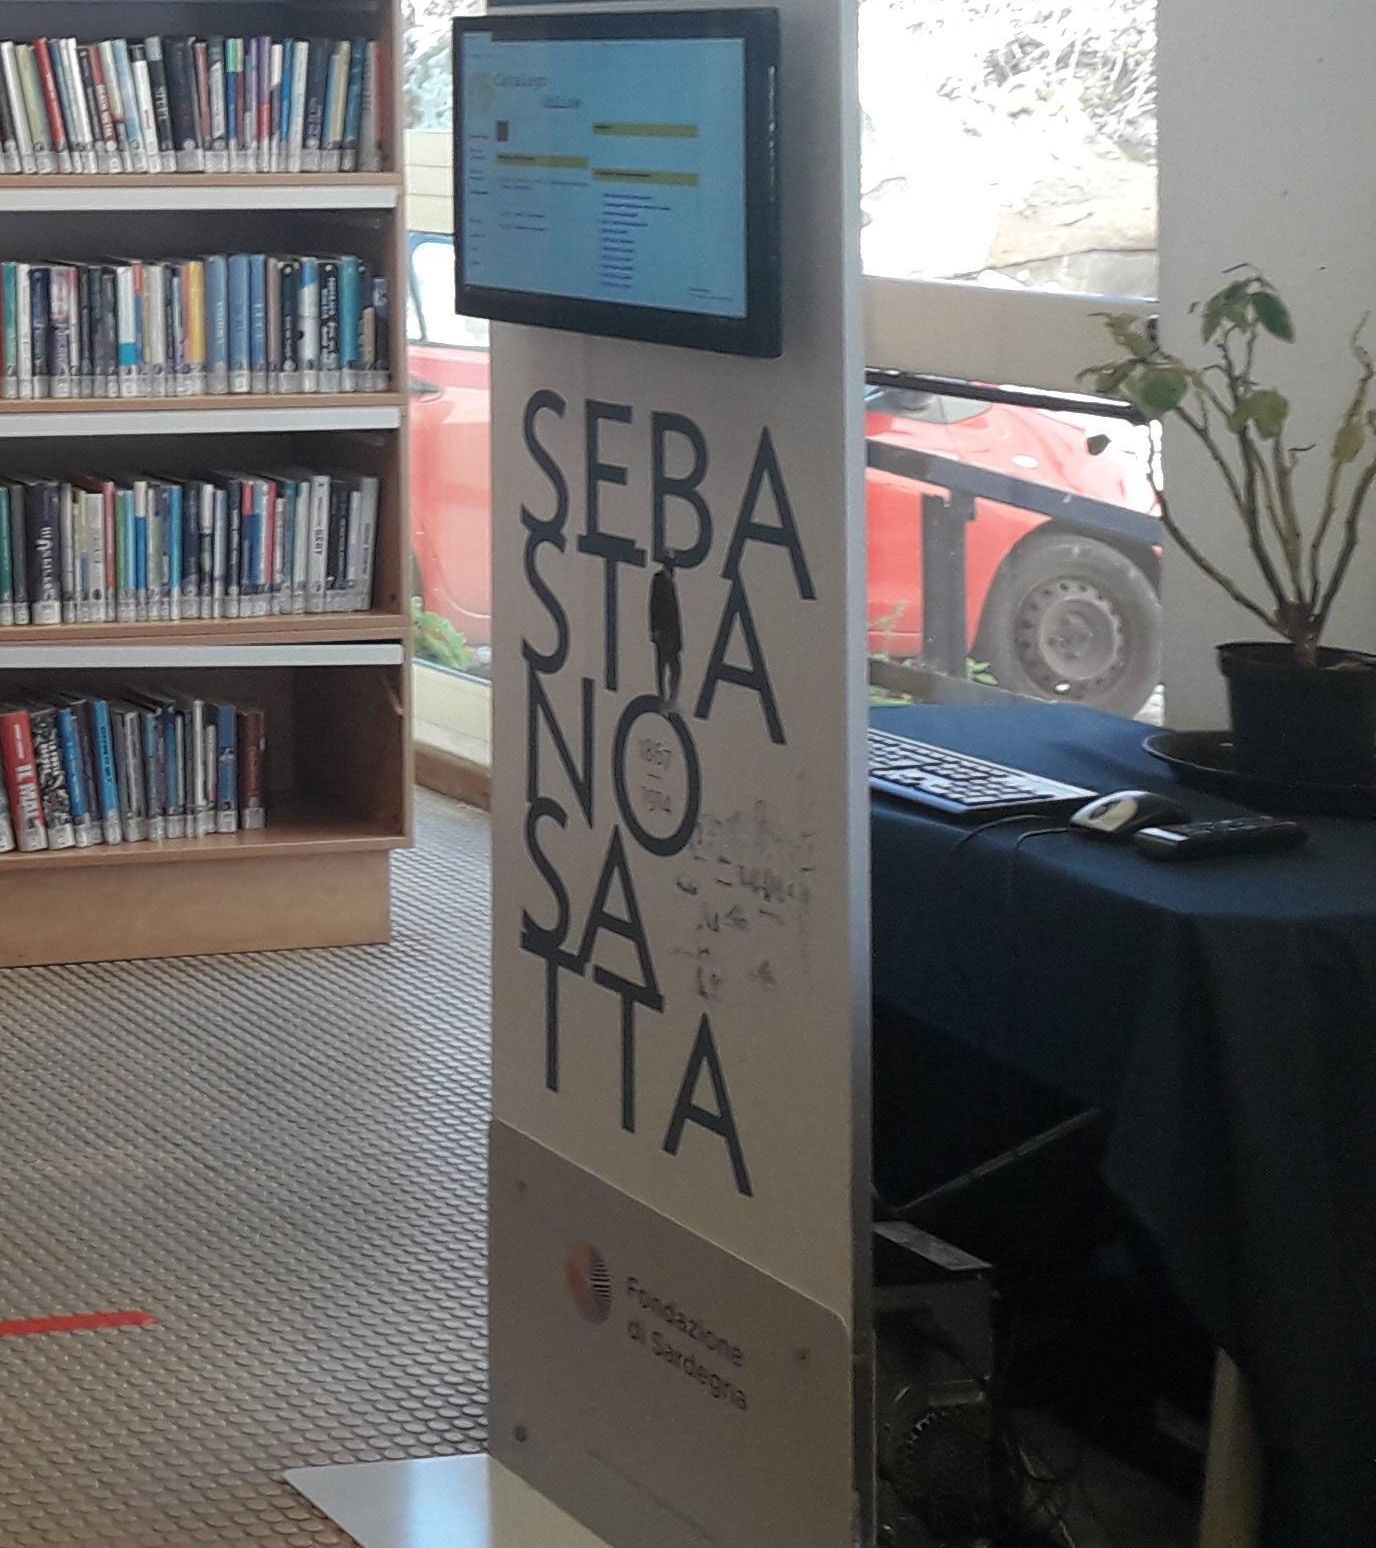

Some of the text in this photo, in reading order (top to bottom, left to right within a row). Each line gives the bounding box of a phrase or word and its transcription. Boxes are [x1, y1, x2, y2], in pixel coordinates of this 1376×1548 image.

[520, 388, 817, 601] SEBA
[526, 665, 702, 857] NO
[625, 1276, 744, 1367] Fondazione
[626, 1320, 748, 1412] di Sardegna
